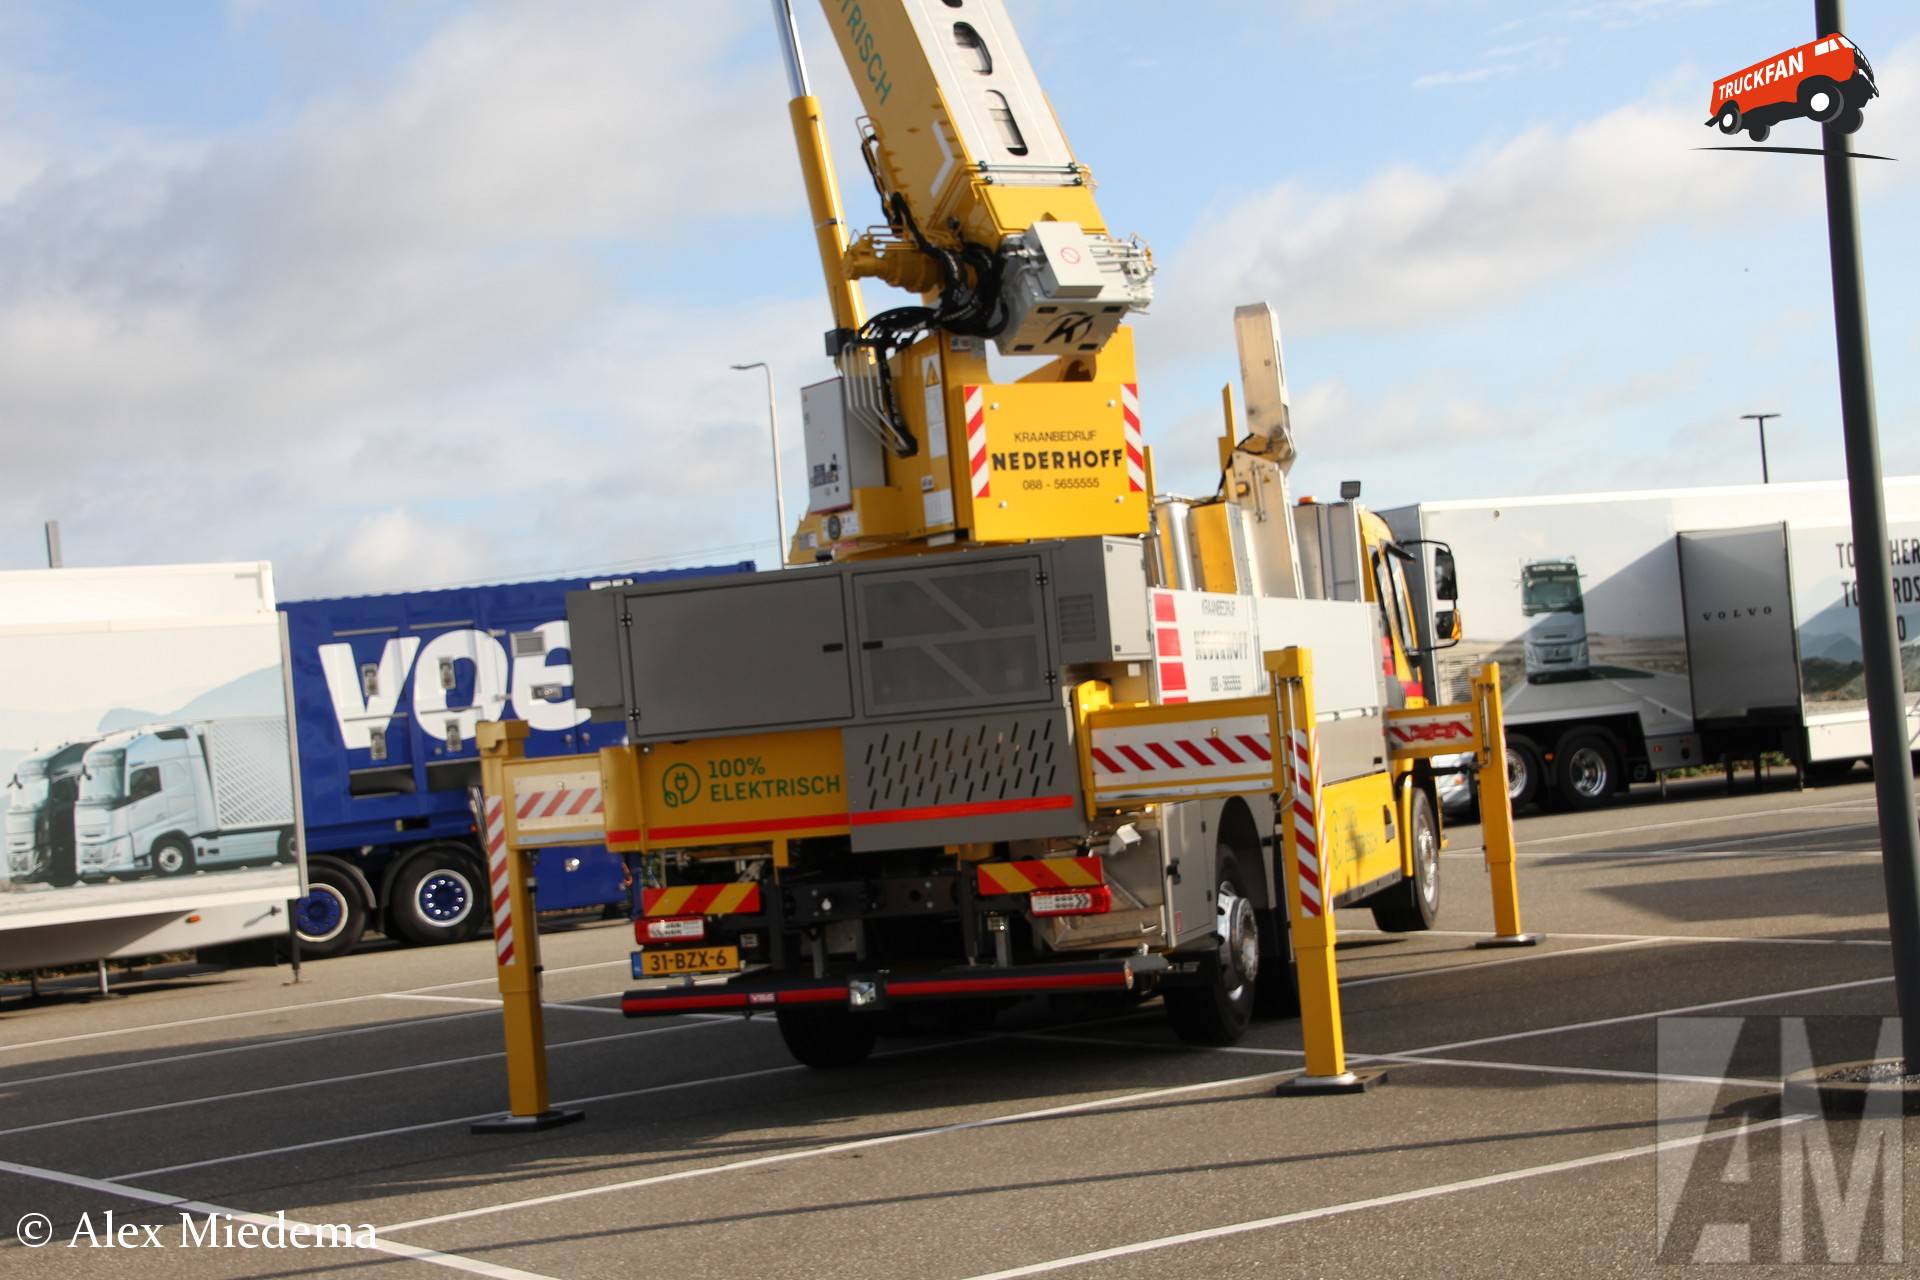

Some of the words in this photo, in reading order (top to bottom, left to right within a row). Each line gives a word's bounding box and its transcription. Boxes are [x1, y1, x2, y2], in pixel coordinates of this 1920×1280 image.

[1014, 430, 1097, 442] KRAANBEDRIJF
[991, 449, 1123, 471] NEDERHOFF
[1022, 480, 1043, 490] 088
[1836, 539, 1920, 569] TOHER
[1841, 577, 1920, 607] TORDS
[1702, 606, 1772, 621] VOLVO
[707, 757, 766, 779] 100%
[710, 775, 841, 802] ELEKTRISCH
[651, 950, 727, 972] 31-BZX-6
